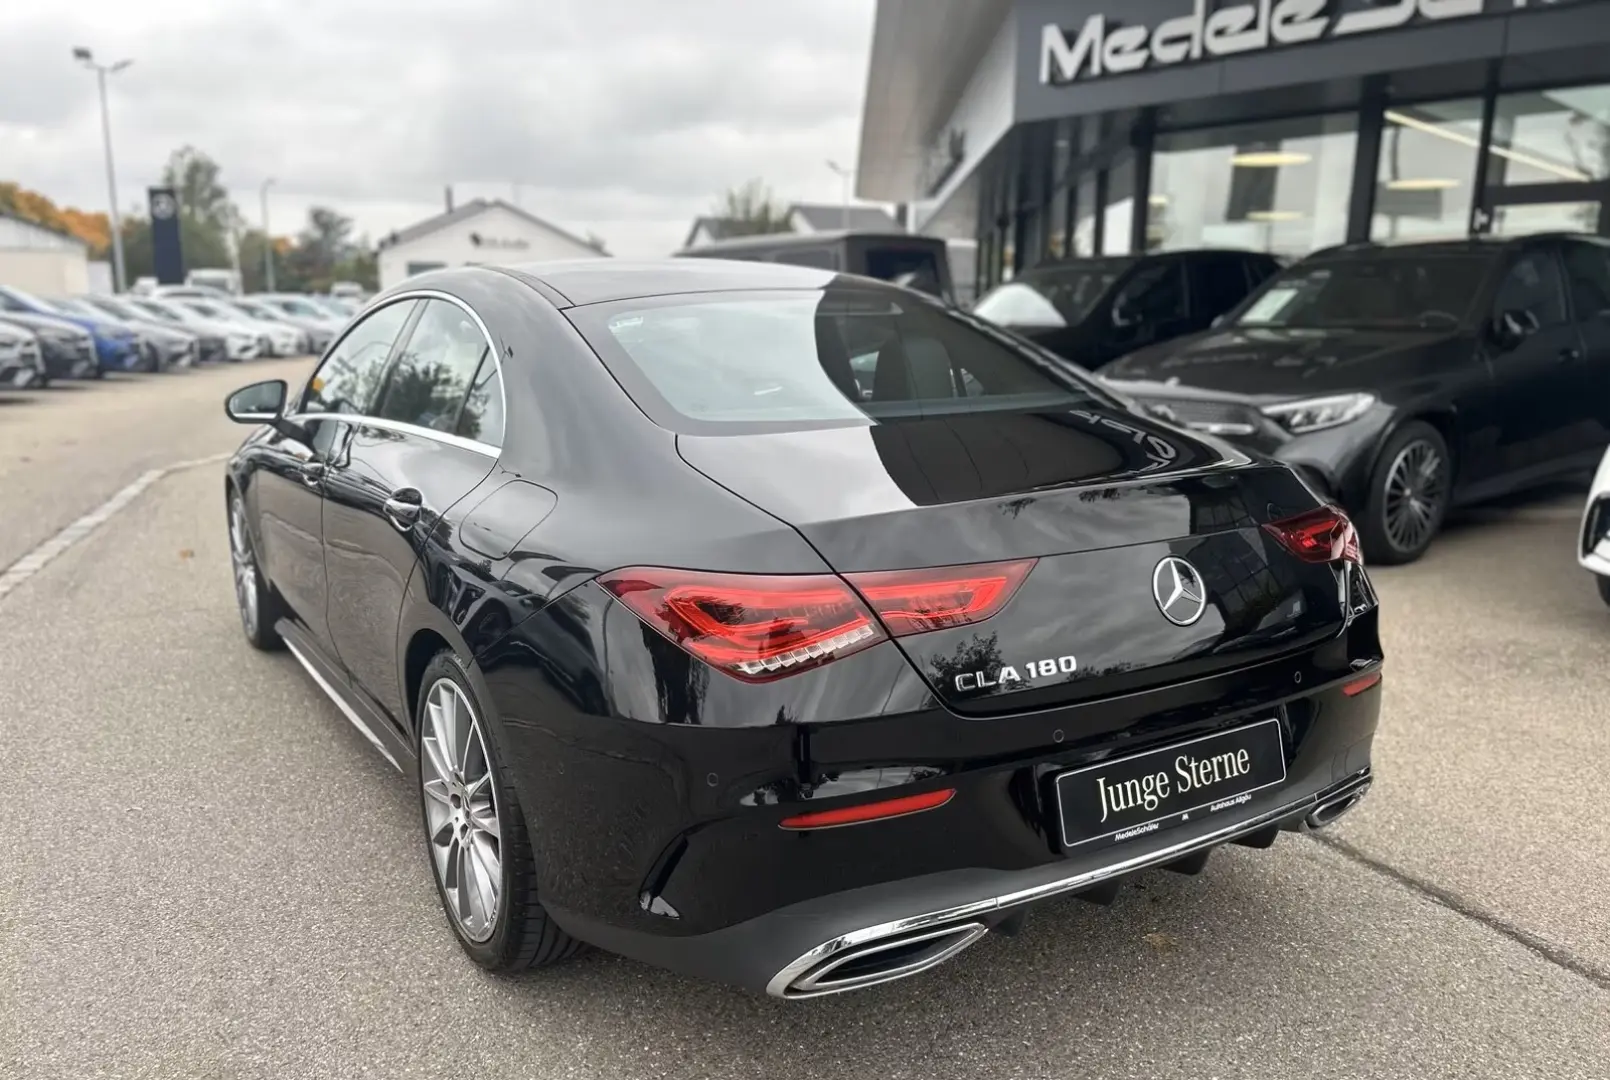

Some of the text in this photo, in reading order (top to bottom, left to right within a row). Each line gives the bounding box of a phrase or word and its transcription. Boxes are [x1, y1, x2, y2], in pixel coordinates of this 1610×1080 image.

[955, 655, 1077, 692] CLA 180
[1096, 748, 1250, 823] Junge Sterne
